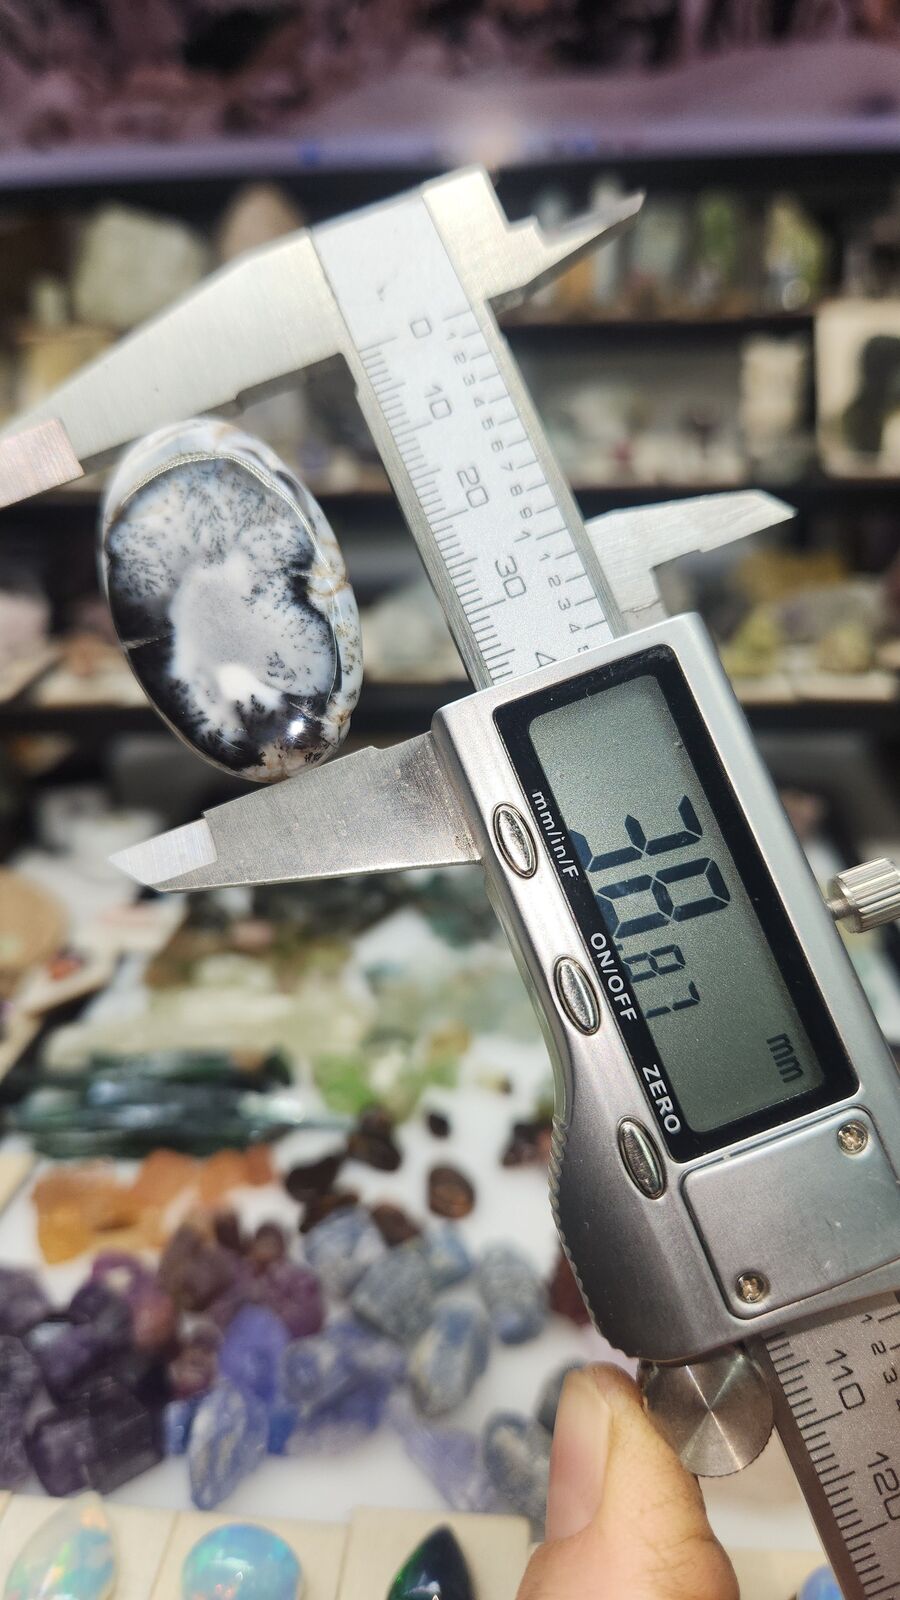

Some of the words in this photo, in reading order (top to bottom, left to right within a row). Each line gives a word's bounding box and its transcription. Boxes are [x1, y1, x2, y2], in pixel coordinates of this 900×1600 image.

[409, 317, 432, 339] 0
[453, 352, 467, 365] 2
[463, 373, 476, 387] 3
[424, 384, 453, 420] 10
[473, 397, 486, 408] 4
[481, 417, 495, 431] 5
[490, 440, 504, 453] 6
[501, 461, 514, 473] 7
[456, 466, 490, 509] 20
[510, 484, 524, 497] 8
[519, 506, 533, 520] 9
[514, 530, 531, 543] 1
[539, 552, 551, 561] 1
[495, 555, 527, 599] 30
[548, 574, 562, 588] 2
[557, 598, 571, 611] 3
[568, 622, 581, 634] 4
[532, 791, 579, 879] mm/in/F
[590, 932, 638, 1022] ON/OFF
[766, 1033, 804, 1083] mm
[641, 1064, 681, 1135] ZERO
[861, 1313, 873, 1324] 1
[870, 1340, 886, 1355] 2
[825, 1348, 866, 1410] 110
[882, 1367, 898, 1384] 3
